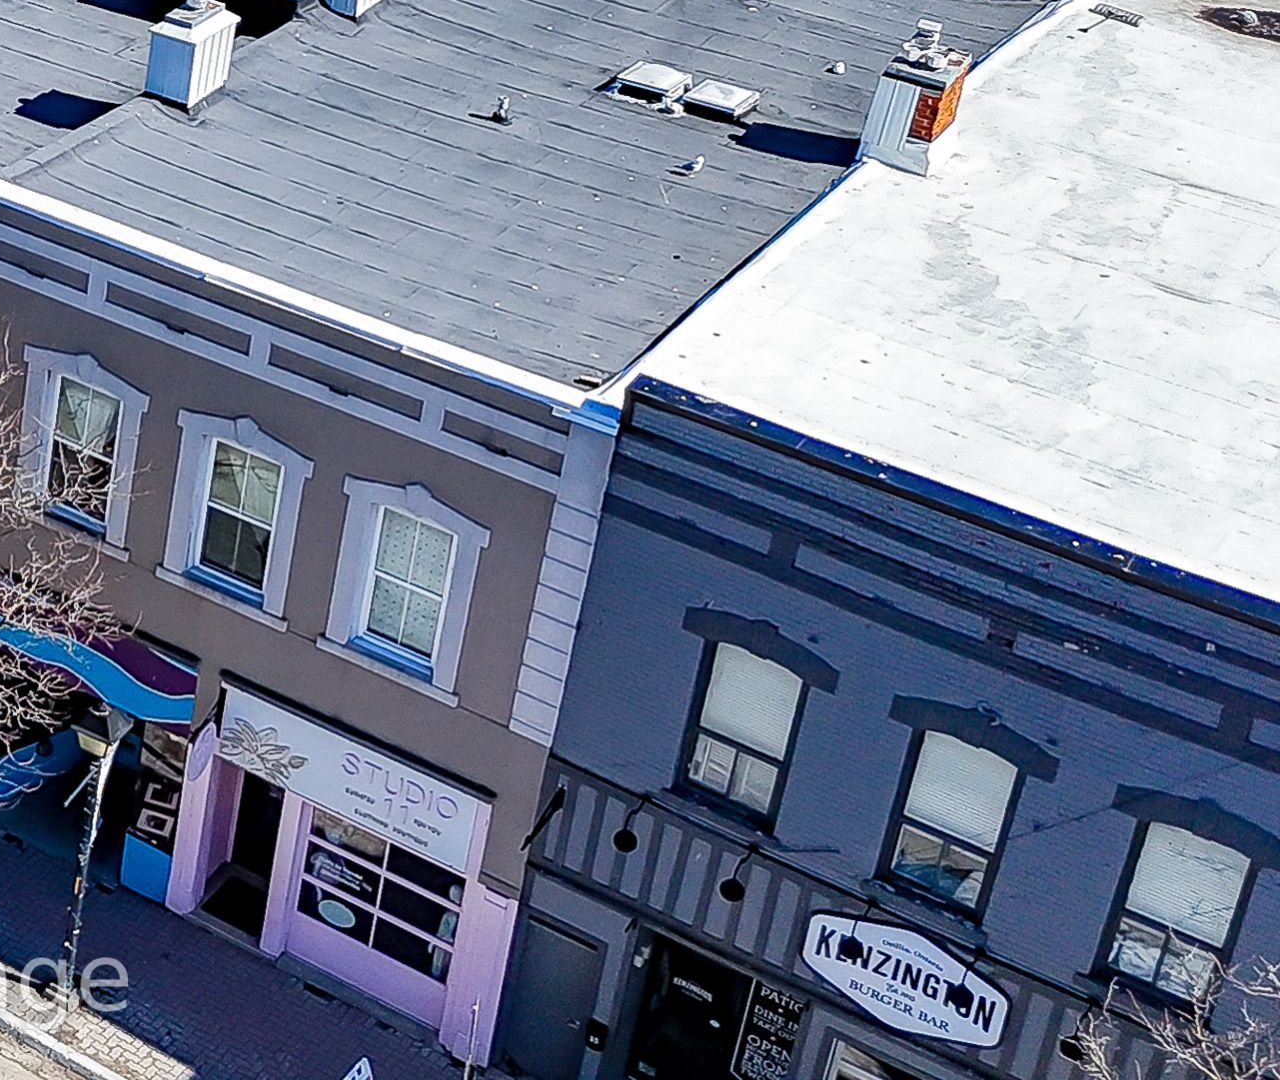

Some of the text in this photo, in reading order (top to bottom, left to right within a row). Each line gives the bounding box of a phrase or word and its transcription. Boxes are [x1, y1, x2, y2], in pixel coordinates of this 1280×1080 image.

[340, 751, 460, 820] STUDIO
[848, 978, 951, 1034] BURGER BAR
